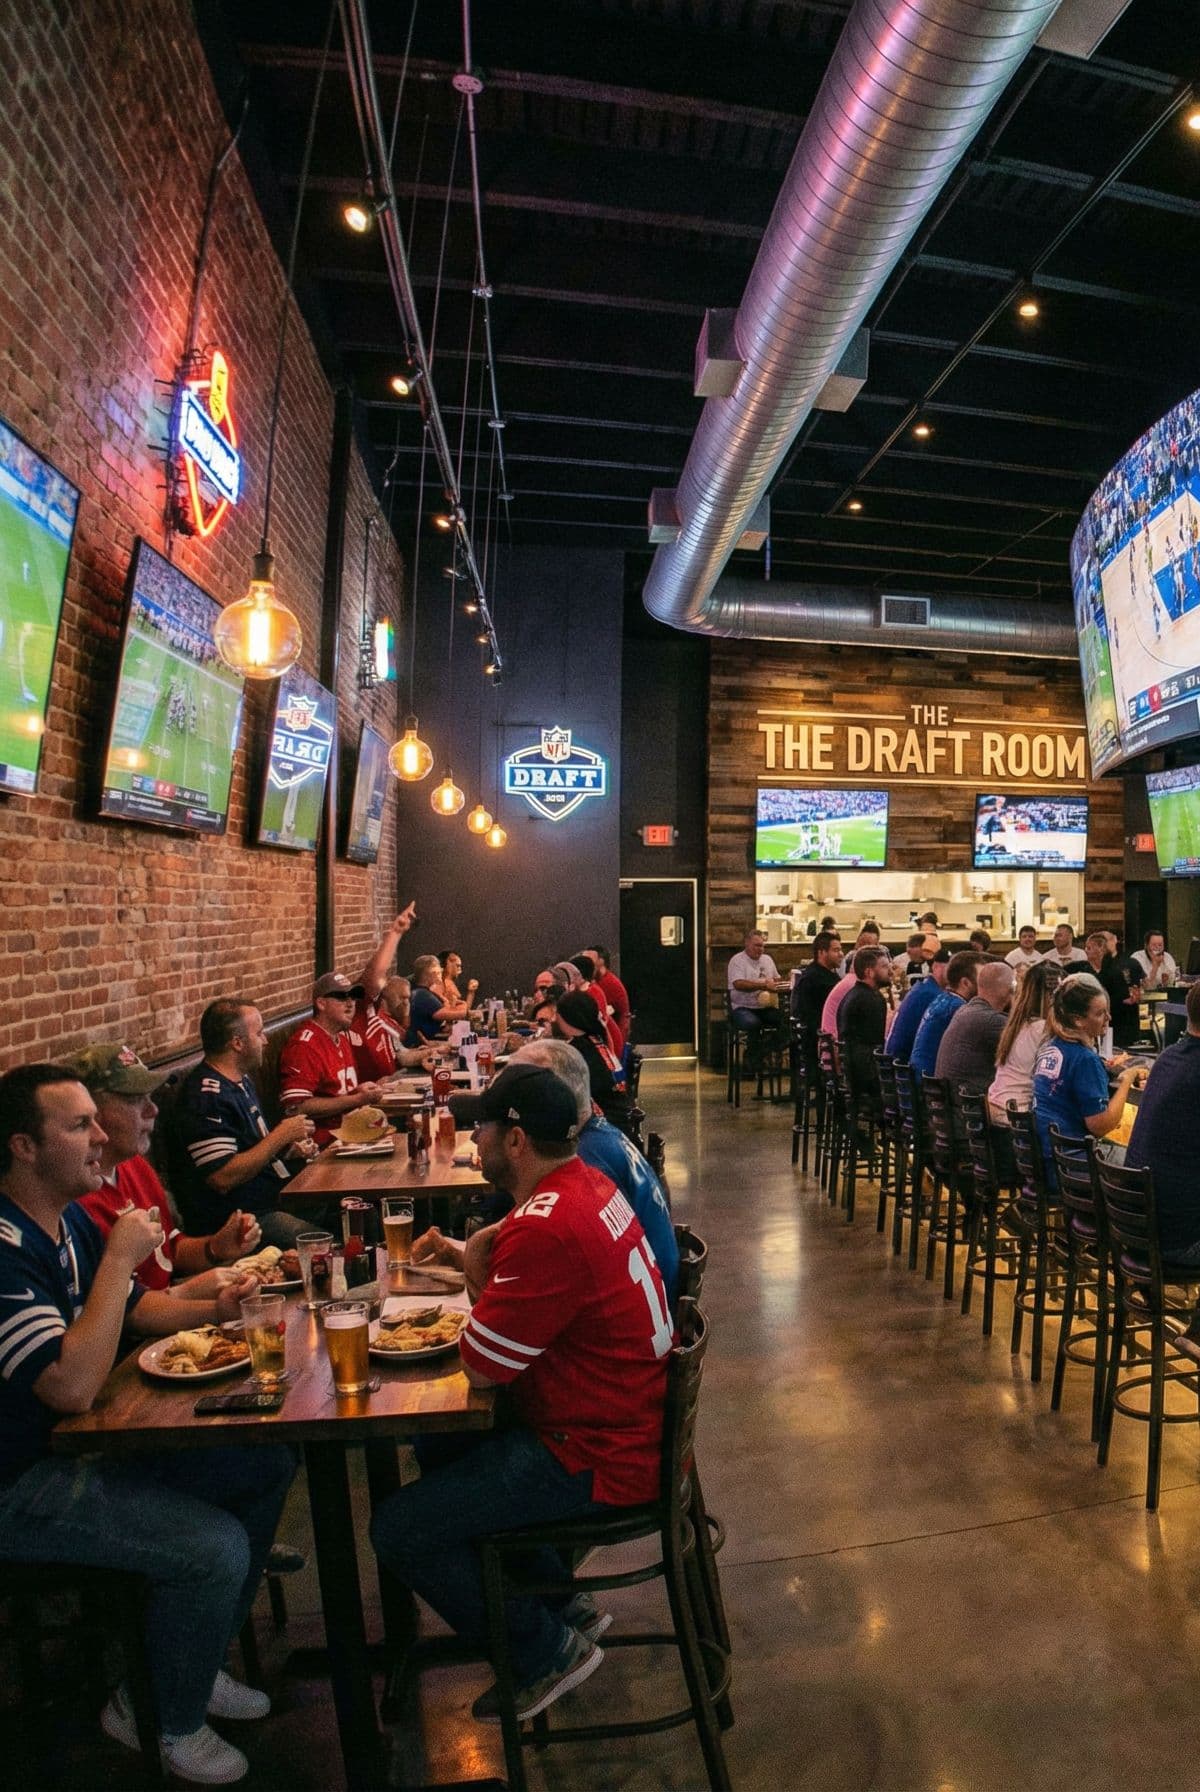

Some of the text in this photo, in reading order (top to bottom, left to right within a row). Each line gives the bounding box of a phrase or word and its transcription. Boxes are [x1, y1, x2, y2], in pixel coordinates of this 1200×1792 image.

[911, 704, 949, 726] THE
[758, 723, 834, 771] THE
[847, 726, 971, 775] DRAFT
[982, 732, 1086, 779] ROOM
[513, 768, 597, 787] DRAFT
[513, 1191, 560, 1219] 12
[628, 1235, 675, 1359] 1
